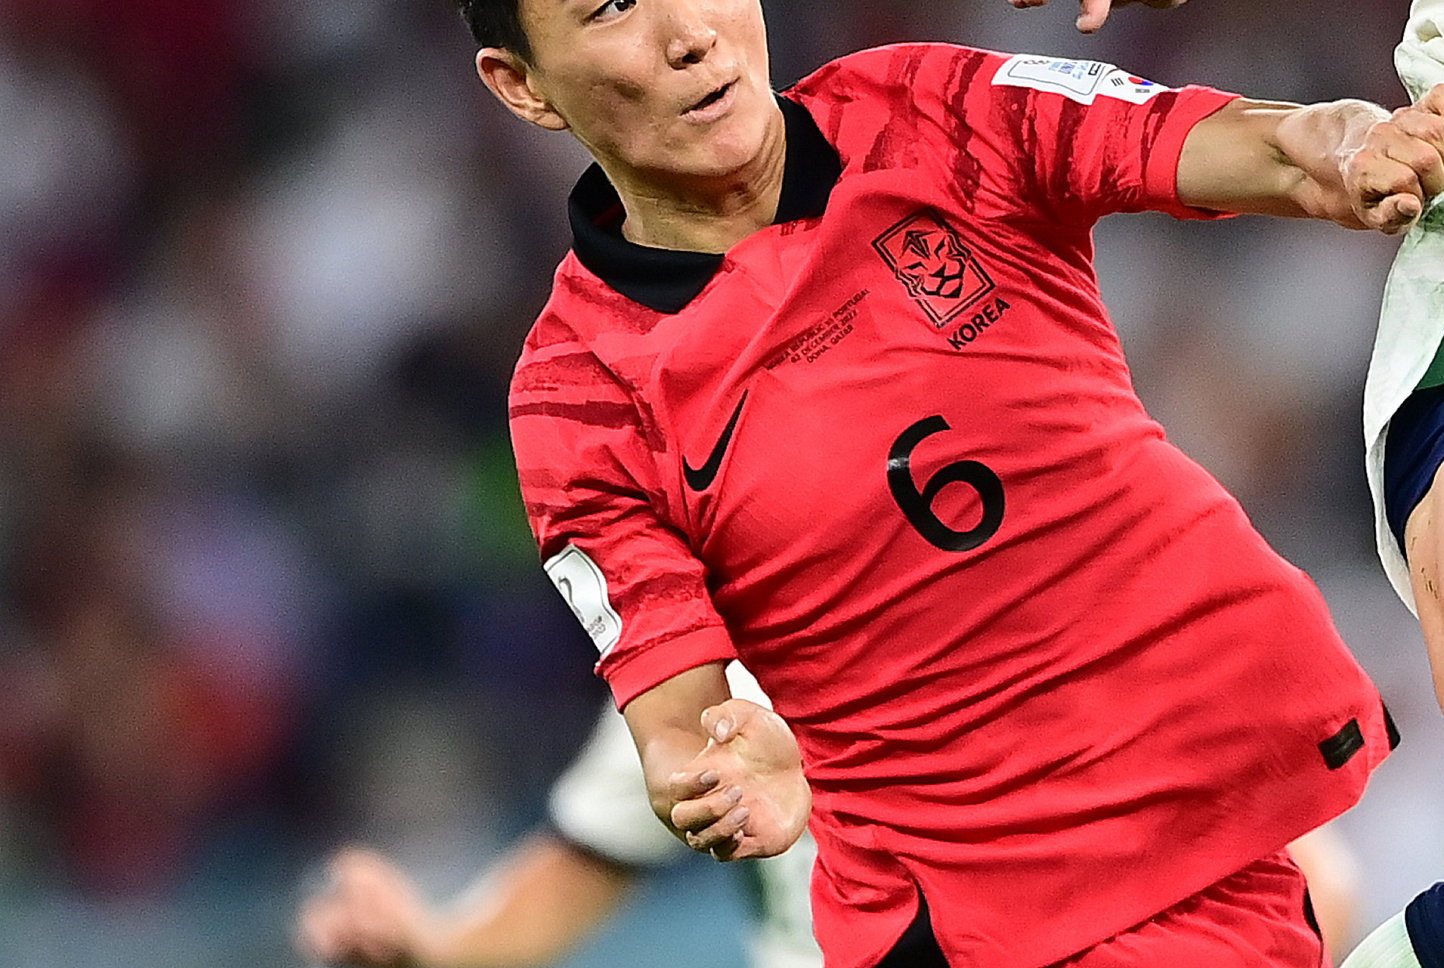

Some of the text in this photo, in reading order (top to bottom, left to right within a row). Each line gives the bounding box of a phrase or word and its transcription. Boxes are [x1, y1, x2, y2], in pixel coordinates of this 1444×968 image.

[832, 288, 870, 319] PORTUGAL
[947, 297, 1011, 350] KOREA
[801, 323, 840, 356] DECEMBER
[841, 309, 857, 326] 2022
[830, 324, 854, 345] QATAR
[887, 414, 1006, 552] 6
